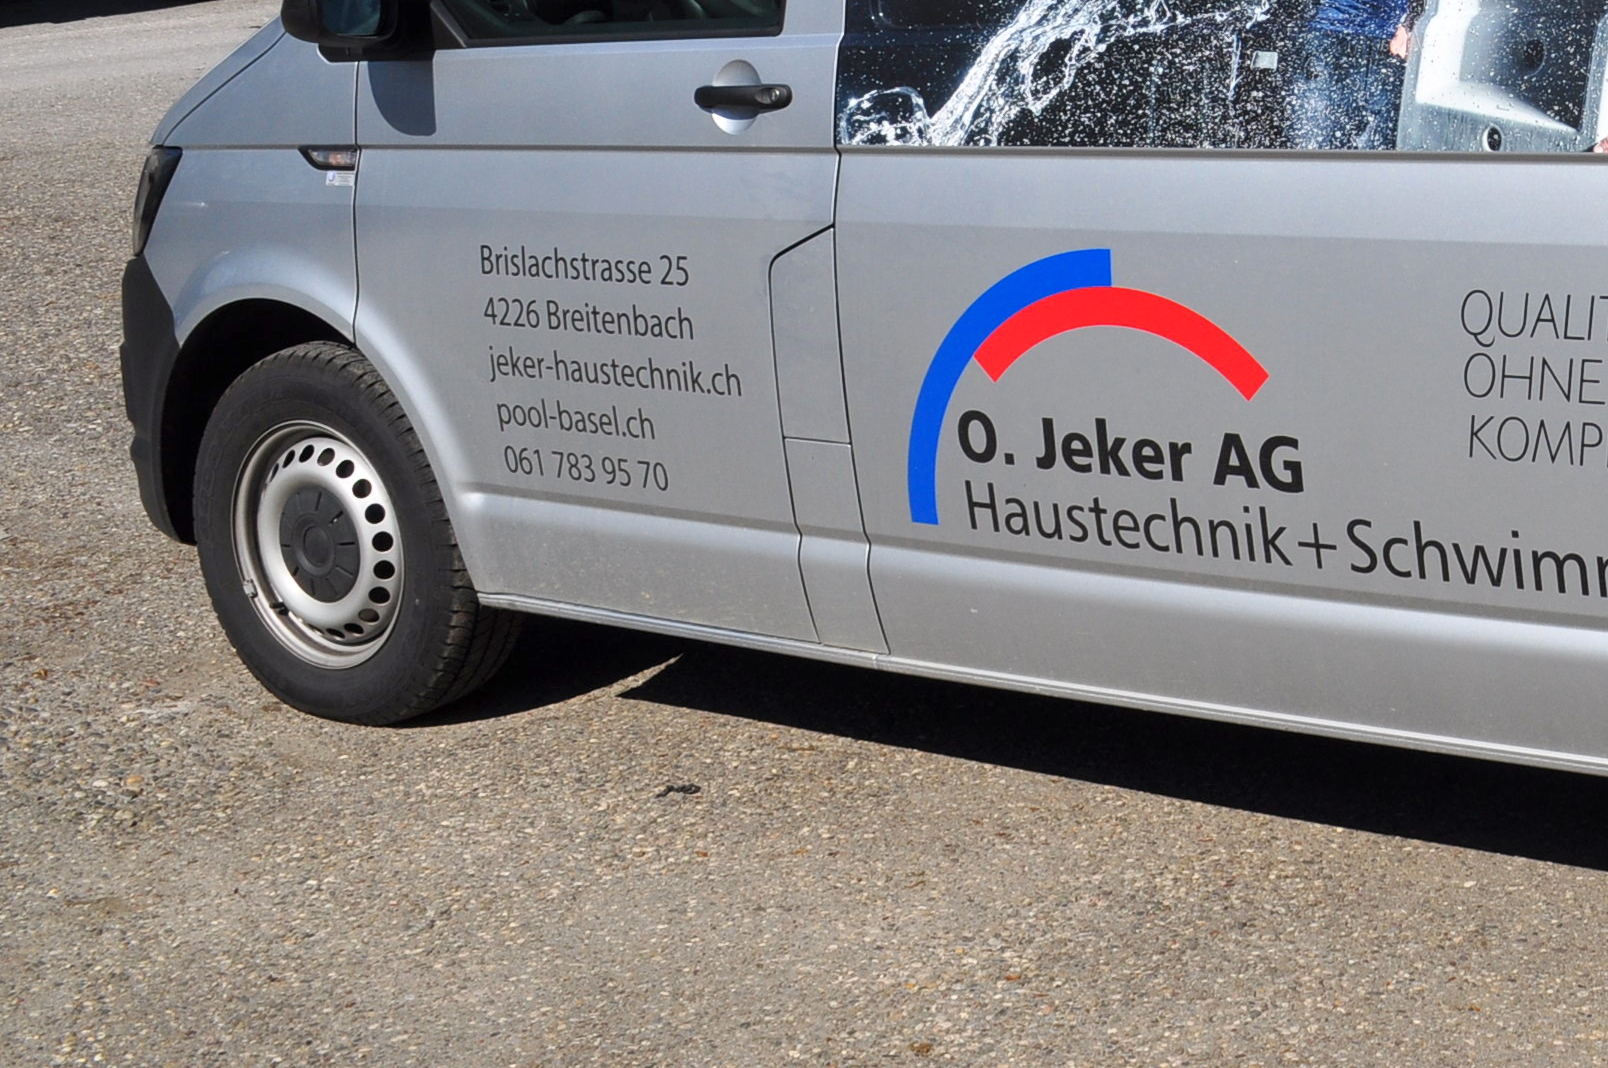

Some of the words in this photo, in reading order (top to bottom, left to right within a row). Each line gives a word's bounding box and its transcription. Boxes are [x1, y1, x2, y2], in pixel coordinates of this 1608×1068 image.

[480, 244, 652, 284] Brislachstrasse
[659, 254, 690, 287] 25
[483, 296, 540, 329] 4226
[546, 299, 694, 340] Breitenbach
[489, 345, 742, 397] jeker-haustechnik.ch
[1463, 352, 1606, 405] OHNE
[496, 398, 656, 440] pool-basel.ch
[504, 445, 544, 477] 061
[551, 450, 596, 483] 783
[601, 456, 632, 487] 95
[636, 460, 669, 492] 70
[957, 409, 1015, 466] O.
[1035, 417, 1193, 482] Jeker
[1212, 432, 1305, 494] AG
